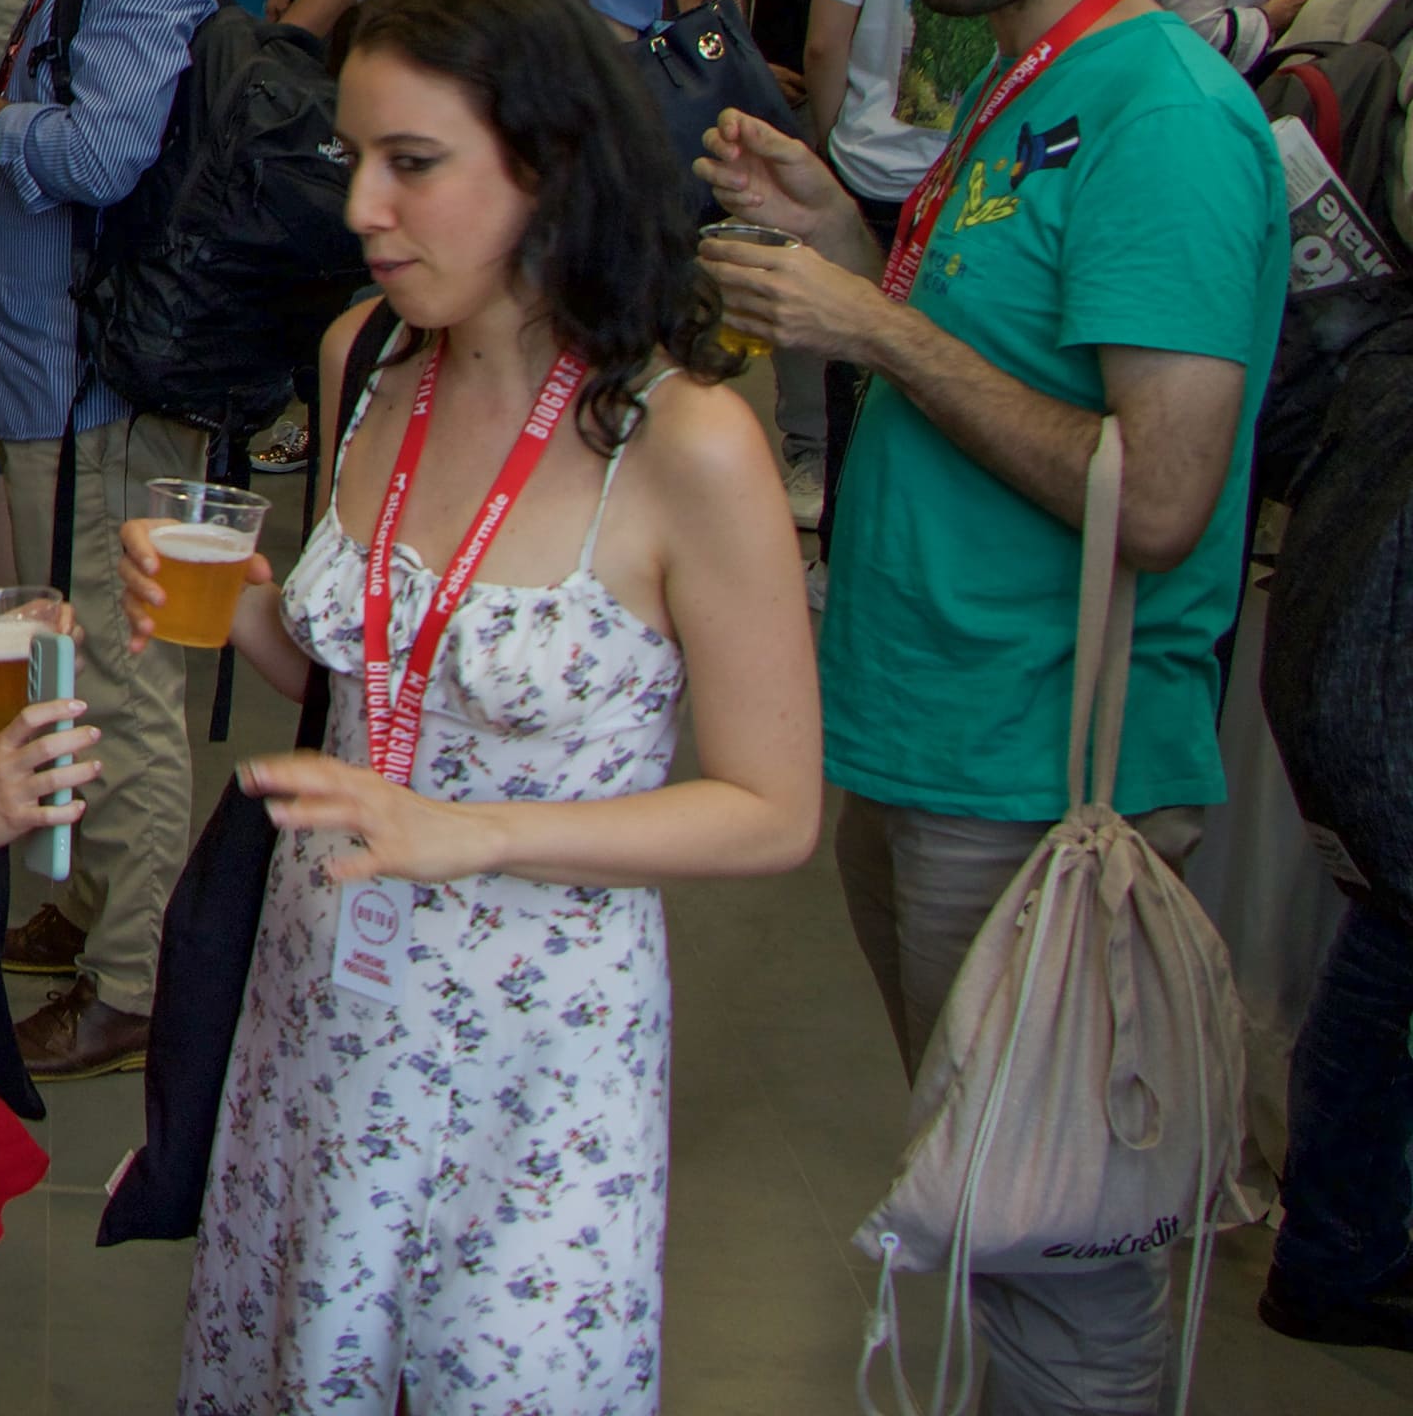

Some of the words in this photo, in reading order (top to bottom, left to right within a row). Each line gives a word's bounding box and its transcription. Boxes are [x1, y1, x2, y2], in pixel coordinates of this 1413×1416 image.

[978, 52, 1040, 125] stickermule
[369, 492, 401, 597] stickermule
[448, 493, 510, 594] stickermule
[383, 670, 427, 784] BIOGRAFILM
[1073, 1215, 1180, 1260] UniCredit
